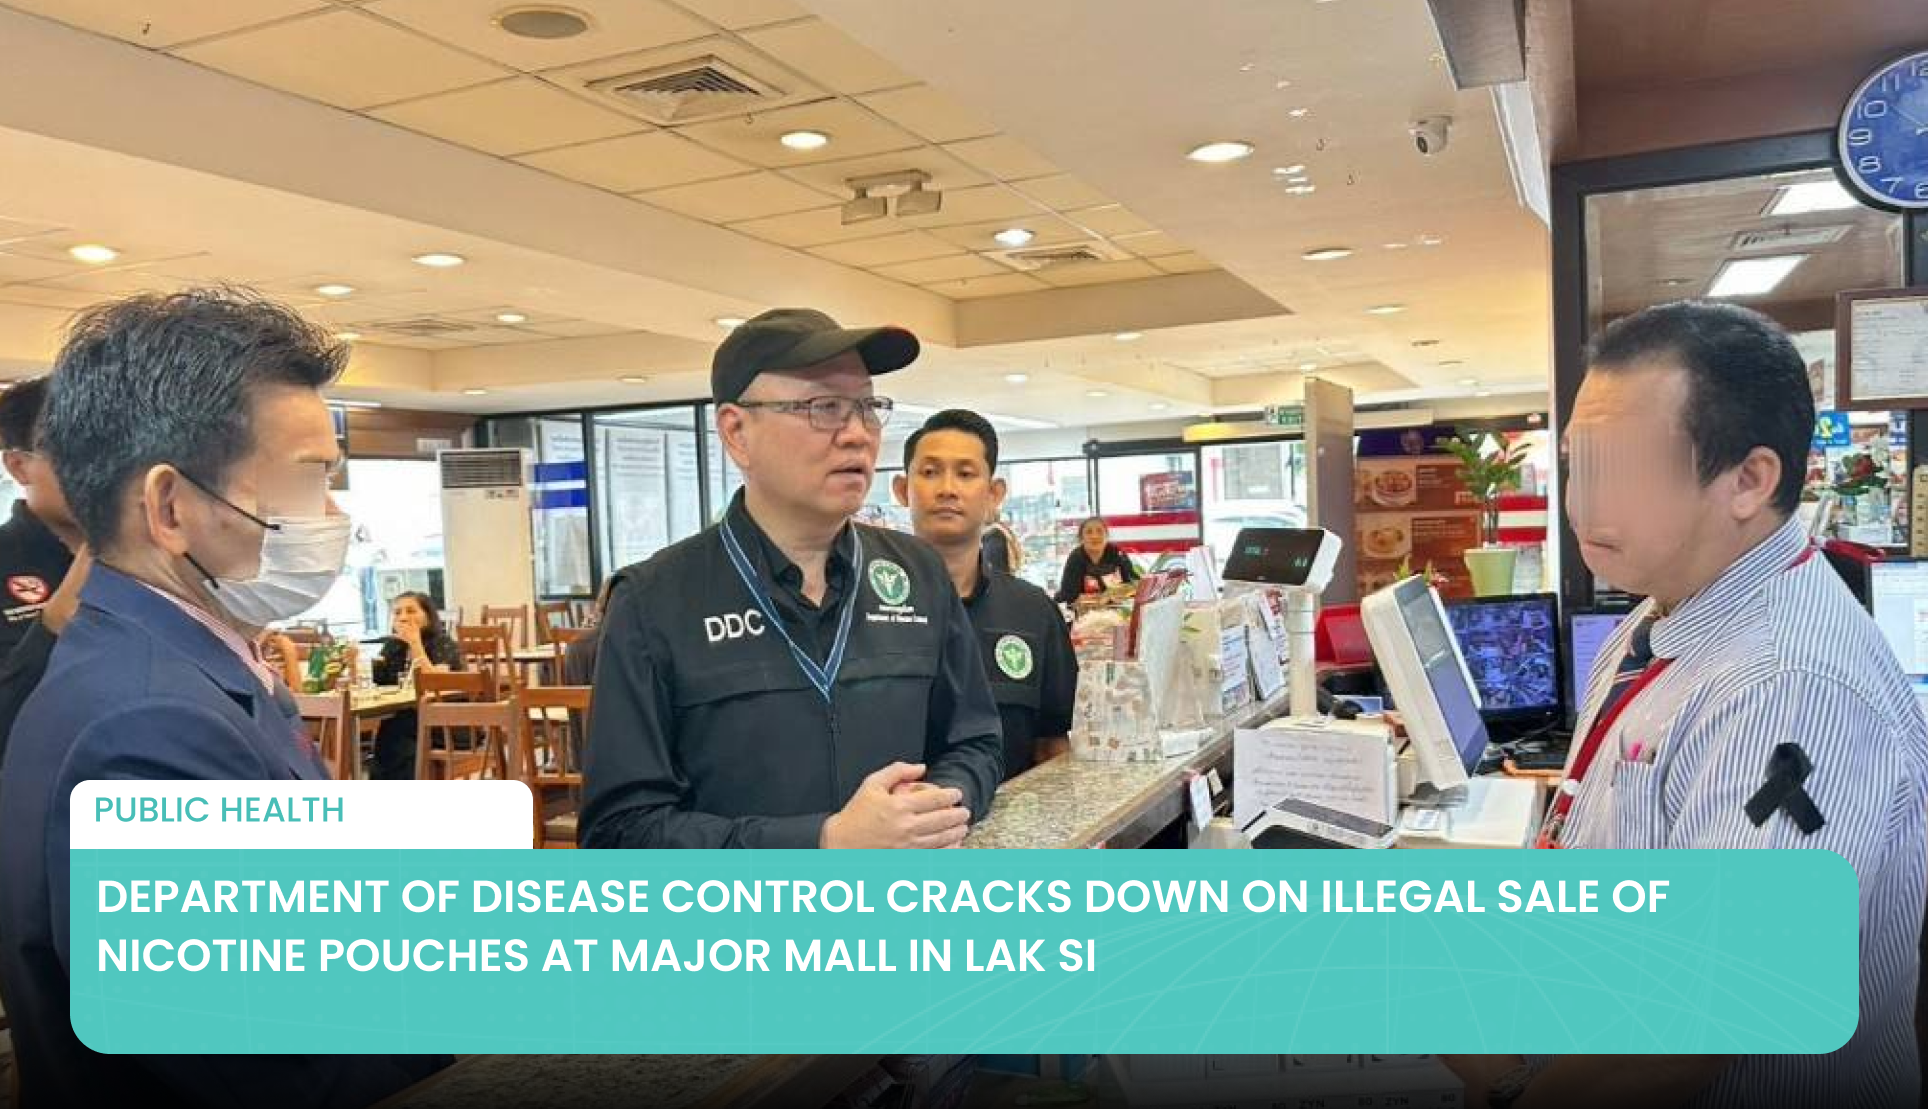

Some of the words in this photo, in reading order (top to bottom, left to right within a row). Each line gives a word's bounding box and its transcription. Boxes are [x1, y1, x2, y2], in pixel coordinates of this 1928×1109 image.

[1882, 73, 1899, 91] 11
[1857, 100, 1886, 119] 10
[1848, 129, 1872, 146] 9
[1859, 156, 1881, 173] 8
[1880, 176, 1903, 194] 7
[703, 608, 766, 642] DDC
[1385, 1096, 1409, 1106] ZYN
